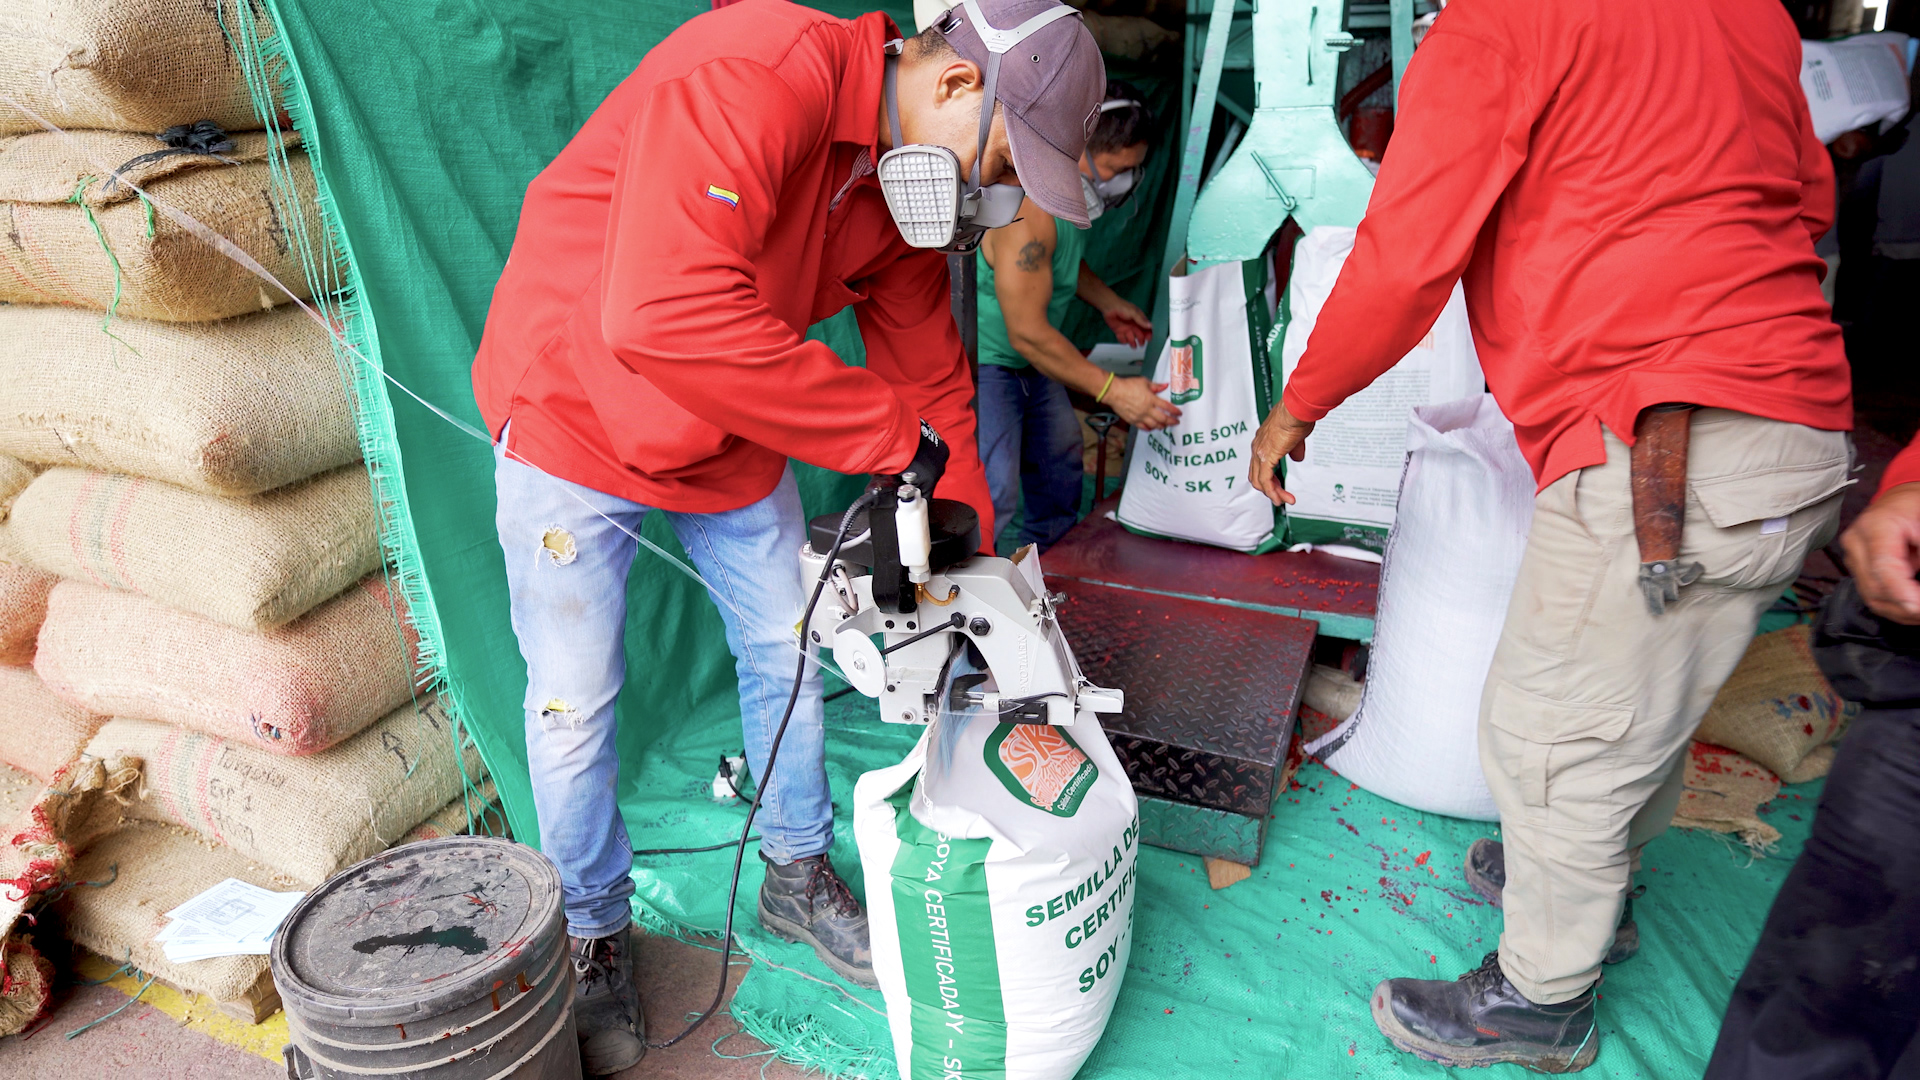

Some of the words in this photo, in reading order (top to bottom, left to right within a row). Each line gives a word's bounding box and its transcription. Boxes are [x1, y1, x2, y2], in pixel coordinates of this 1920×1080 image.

[1147, 433, 1237, 467] CERTIFICADA
[1182, 432, 1205, 446] DE
[1211, 420, 1248, 442] SOYA
[1144, 460, 1168, 484] SOY
[1185, 480, 1212, 493] SK
[1225, 476, 1236, 490] 7
[1018, 634, 1029, 694] NEWLONG
[1065, 762, 1095, 796] Certificada
[1025, 845, 1123, 927] SEMILLA
[1122, 814, 1139, 852] DE
[924, 889, 961, 1010] CERTIFICADA
[1078, 933, 1119, 993] SOY
